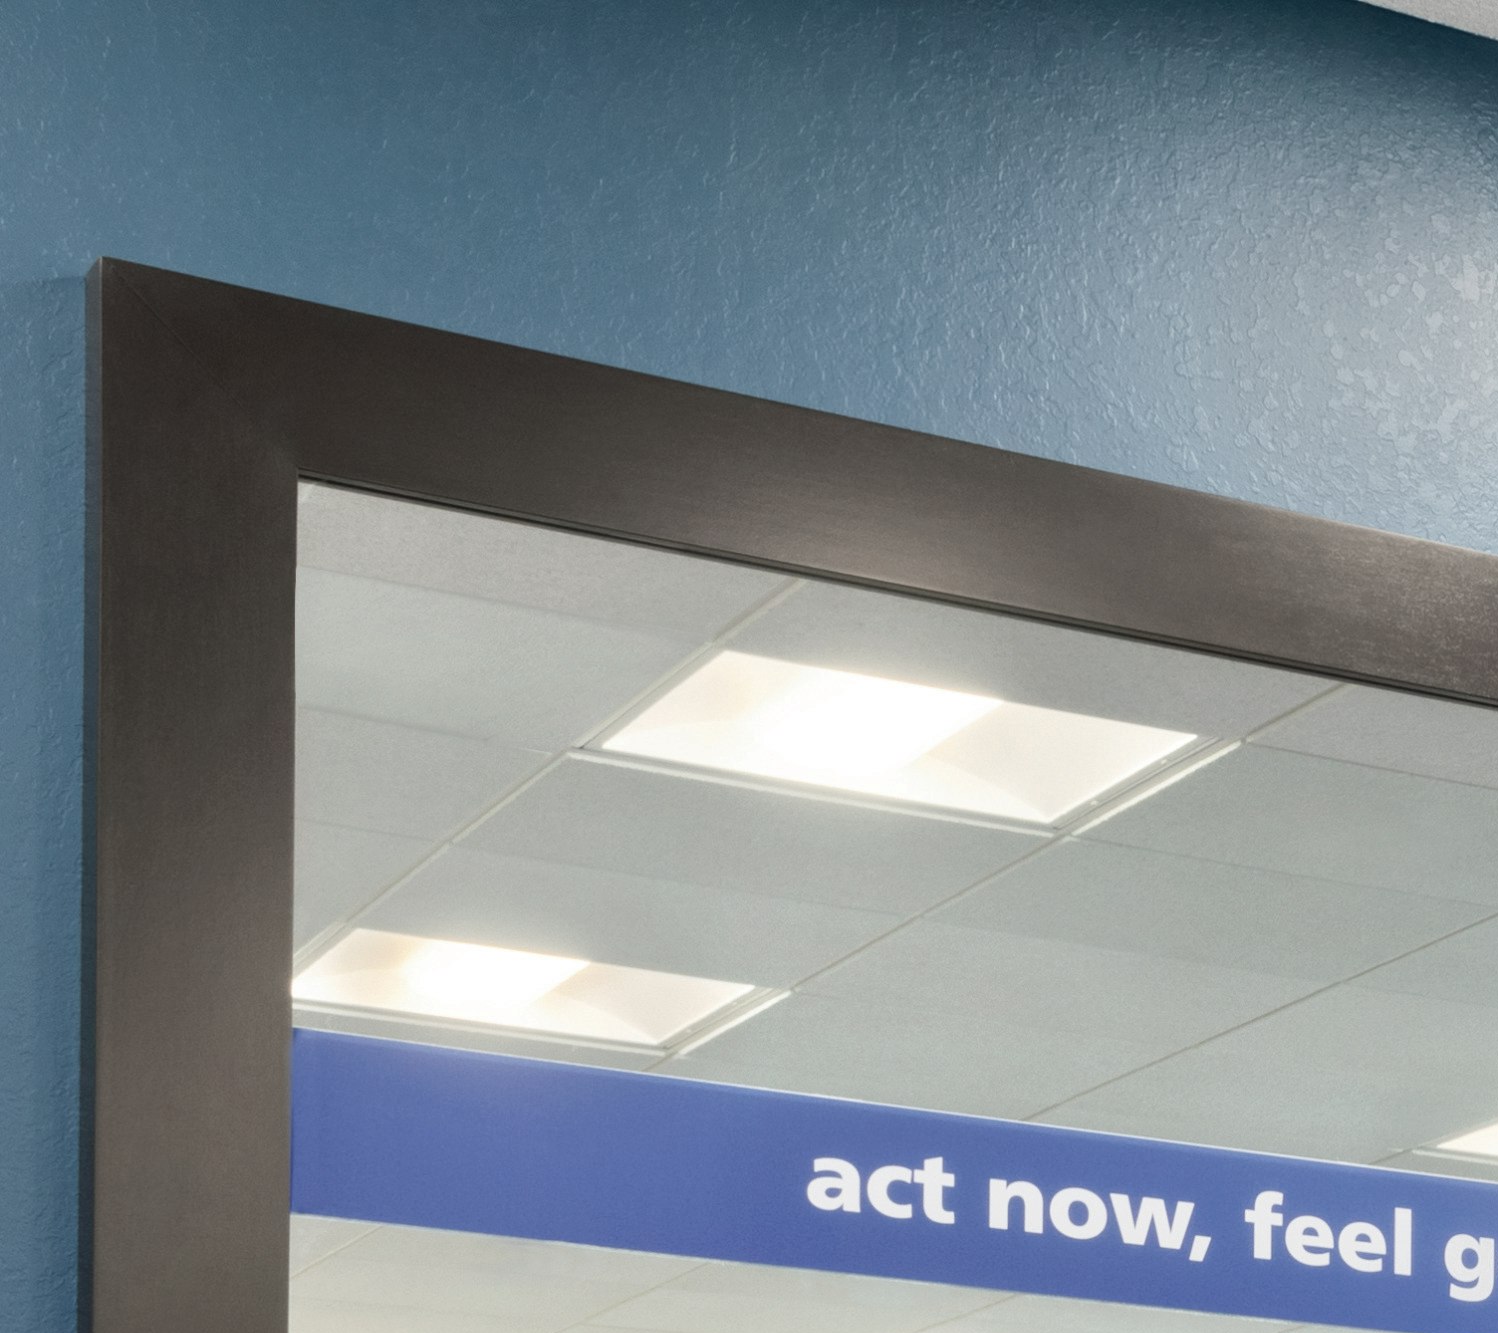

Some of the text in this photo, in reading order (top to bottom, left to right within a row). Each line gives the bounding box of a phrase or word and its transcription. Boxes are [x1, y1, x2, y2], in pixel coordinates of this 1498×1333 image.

[806, 1155, 956, 1225] act
[987, 1177, 1213, 1263] now,
[1243, 1190, 1414, 1276] feel
